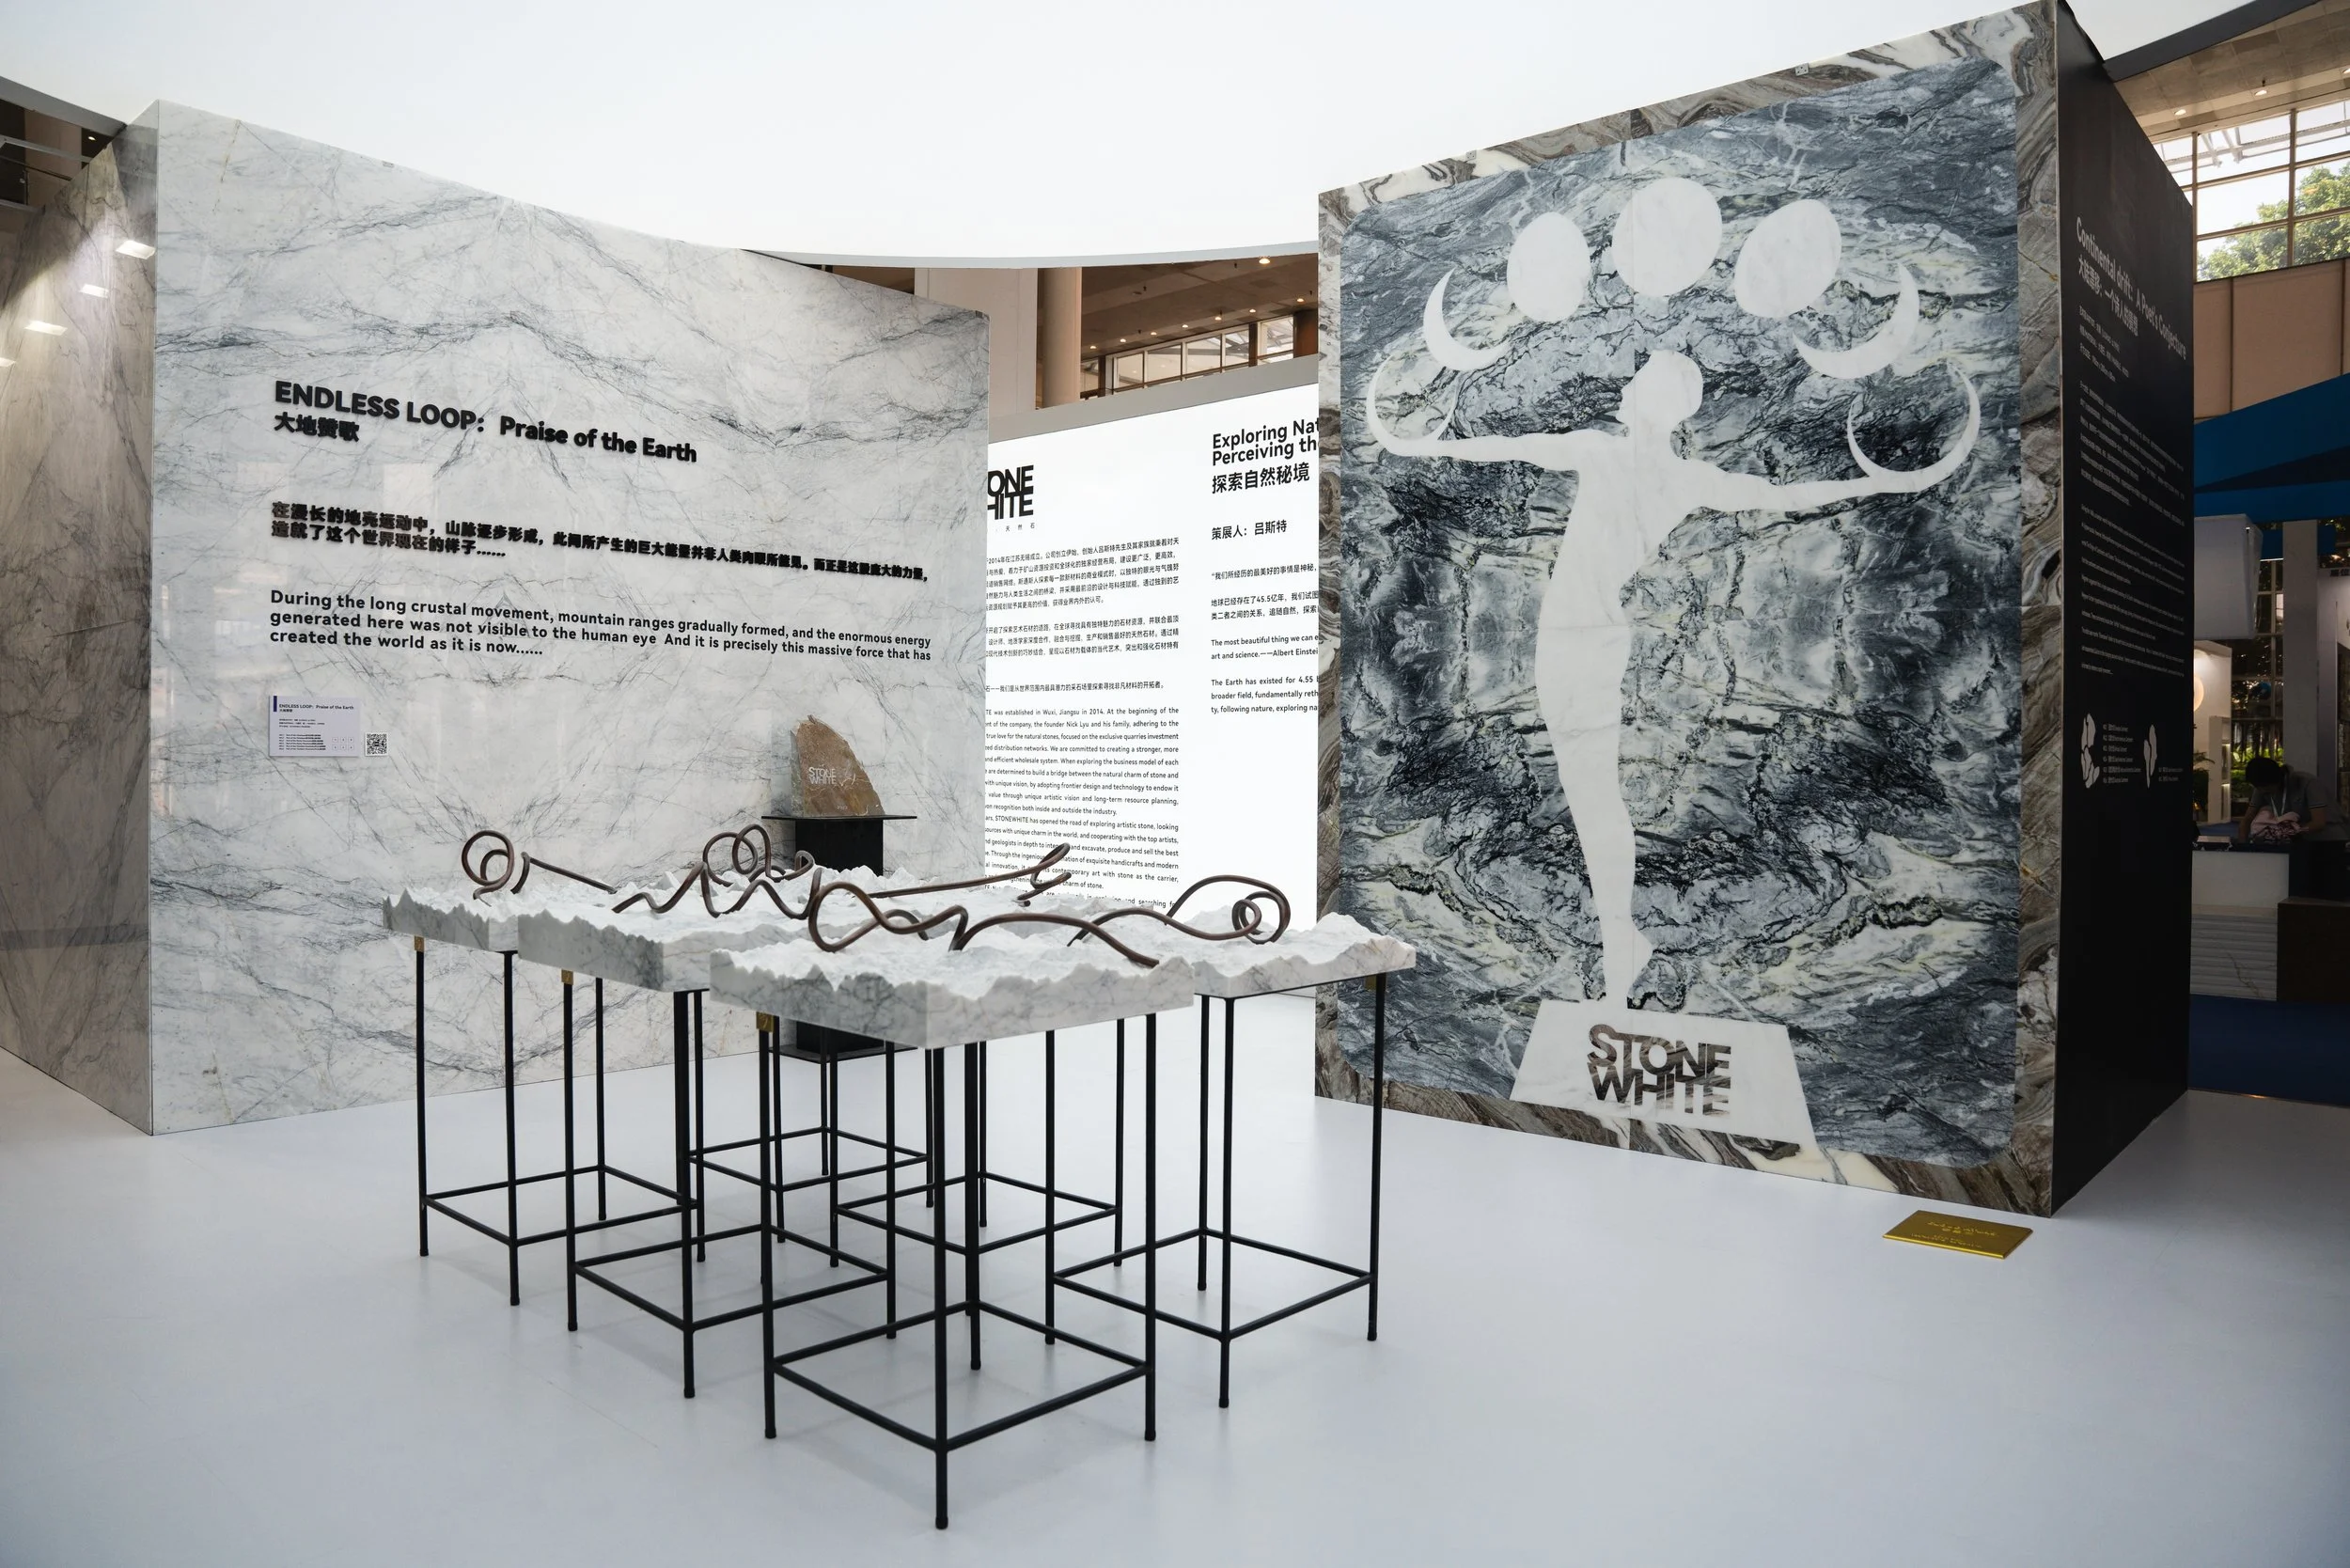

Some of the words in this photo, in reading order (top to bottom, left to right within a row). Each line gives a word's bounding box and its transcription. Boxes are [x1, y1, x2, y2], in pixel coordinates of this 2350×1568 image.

[2076, 216, 2116, 282] Continental
[2136, 288, 2141, 312] A
[2141, 292, 2158, 331] Poet's
[2158, 314, 2186, 361] Conjecture
[274, 380, 400, 420] ENDLESS
[406, 400, 485, 432] LOOP:
[499, 415, 569, 445] Praise
[572, 428, 598, 448] of
[600, 431, 637, 454] the
[642, 436, 697, 463] Earth
[1213, 424, 1288, 451] Exploring
[1213, 441, 1294, 466] Perceiving
[1298, 435, 1318, 452] th
[988, 464, 1034, 498] ONE
[1212, 462, 1310, 494] 探索自然秘境
[1211, 519, 1288, 541] 策展人：吕斯特
[271, 588, 332, 609] During
[336, 593, 365, 609] the
[369, 595, 406, 614] long
[411, 602, 466, 615] crustal
[471, 604, 554, 624] movement,
[557, 612, 624, 626] mountain
[628, 617, 675, 631] ranges
[677, 619, 738, 637] gradually
[741, 621, 791, 639] formed,
[791, 627, 813, 639] and
[816, 627, 836, 640] the
[838, 633, 892, 644] enormous
[894, 635, 931, 650] energy
[269, 630, 337, 645] created
[342, 631, 372, 646] the
[377, 634, 424, 649] world
[430, 639, 446, 650] as
[451, 636, 464, 651] it
[468, 637, 481, 651] is
[270, 611, 360, 627] generated
[367, 614, 403, 630] here
[409, 619, 440, 632] was
[446, 620, 472, 634] not
[478, 621, 529, 637] visible
[531, 625, 547, 637] to
[552, 625, 576, 639] the
[581, 627, 627, 643] human
[632, 633, 657, 647] eye
[664, 633, 690, 646] And
[695, 635, 704, 647] it
[709, 635, 718, 648] is
[723, 638, 777, 654] precisely
[781, 640, 804, 653] this
[807, 643, 852, 656] massive
[855, 645, 884, 658] force
[886, 647, 910, 659] that
[913, 650, 931, 661] has
[1211, 638, 1222, 647] The
[1223, 637, 1239, 646] most
[1240, 635, 1270, 645] beautiful
[1271, 635, 1289, 645] thing
[1210, 651, 1221, 660] art
[1221, 651, 1234, 659] and
[1211, 678, 1222, 686] The
[1225, 677, 1243, 686] Earth
[1245, 677, 1257, 685] has
[1259, 676, 1282, 685] existed
[1285, 675, 1295, 683] for
[1298, 674, 1313, 683] 4.55
[1211, 691, 1236, 699] broader
[1236, 690, 1254, 699] field,
[1254, 689, 1303, 699] fundamentally
[1058, 708, 1079, 717] Jiangsu
[1089, 707, 1104, 715] 2014.
[1127, 706, 1157, 716] beginning
[1159, 705, 1167, 713] of
[1219, 704, 1250, 714] following
[1250, 704, 1275, 713] nature,
[1275, 703, 1308, 713] exploring
[1009, 721, 1032, 729] company,
[1079, 720, 1089, 729] Lyu
[1112, 719, 1131, 729] family,
[1132, 719, 1158, 729] adhering
[1122, 732, 1147, 741] quarries
[808, 766, 837, 778] STONE
[809, 776, 838, 785] WHITE
[1002, 792, 1023, 801] through
[1024, 792, 1042, 801] unique
[1093, 794, 1122, 804] long-term
[1151, 796, 1179, 807] planning,
[1587, 1024, 1731, 1078] STONE
[1587, 1060, 1731, 1117] WHITE
